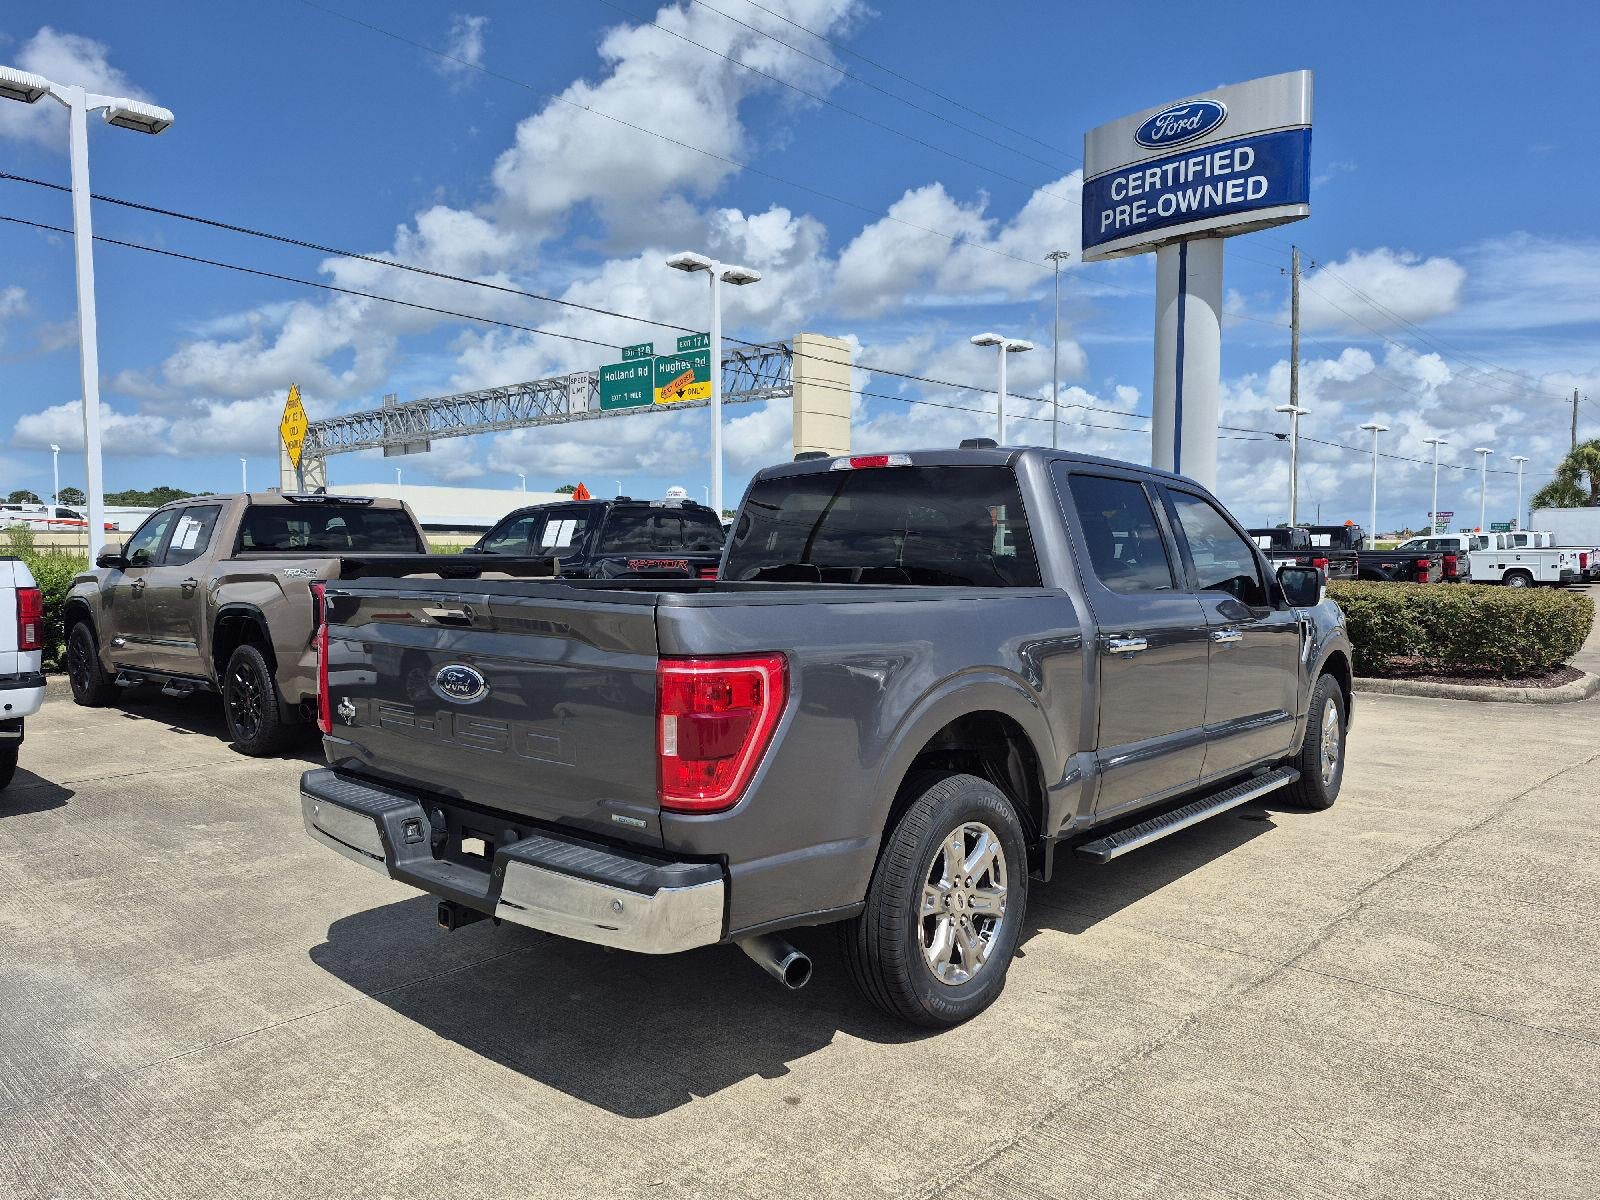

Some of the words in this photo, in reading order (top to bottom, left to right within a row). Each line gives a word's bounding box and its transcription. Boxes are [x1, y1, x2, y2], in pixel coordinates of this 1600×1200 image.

[1152, 108, 1203, 140] Ford
[1111, 147, 1255, 201] CERTIFIED
[1100, 175, 1268, 233] PRE-OWNED
[680, 340, 691, 348] EXIT
[605, 368, 634, 382] Holland
[638, 366, 648, 377] Rd
[659, 359, 690, 374] Hughes
[695, 356, 706, 367] Rd
[687, 386, 705, 396] ONLY
